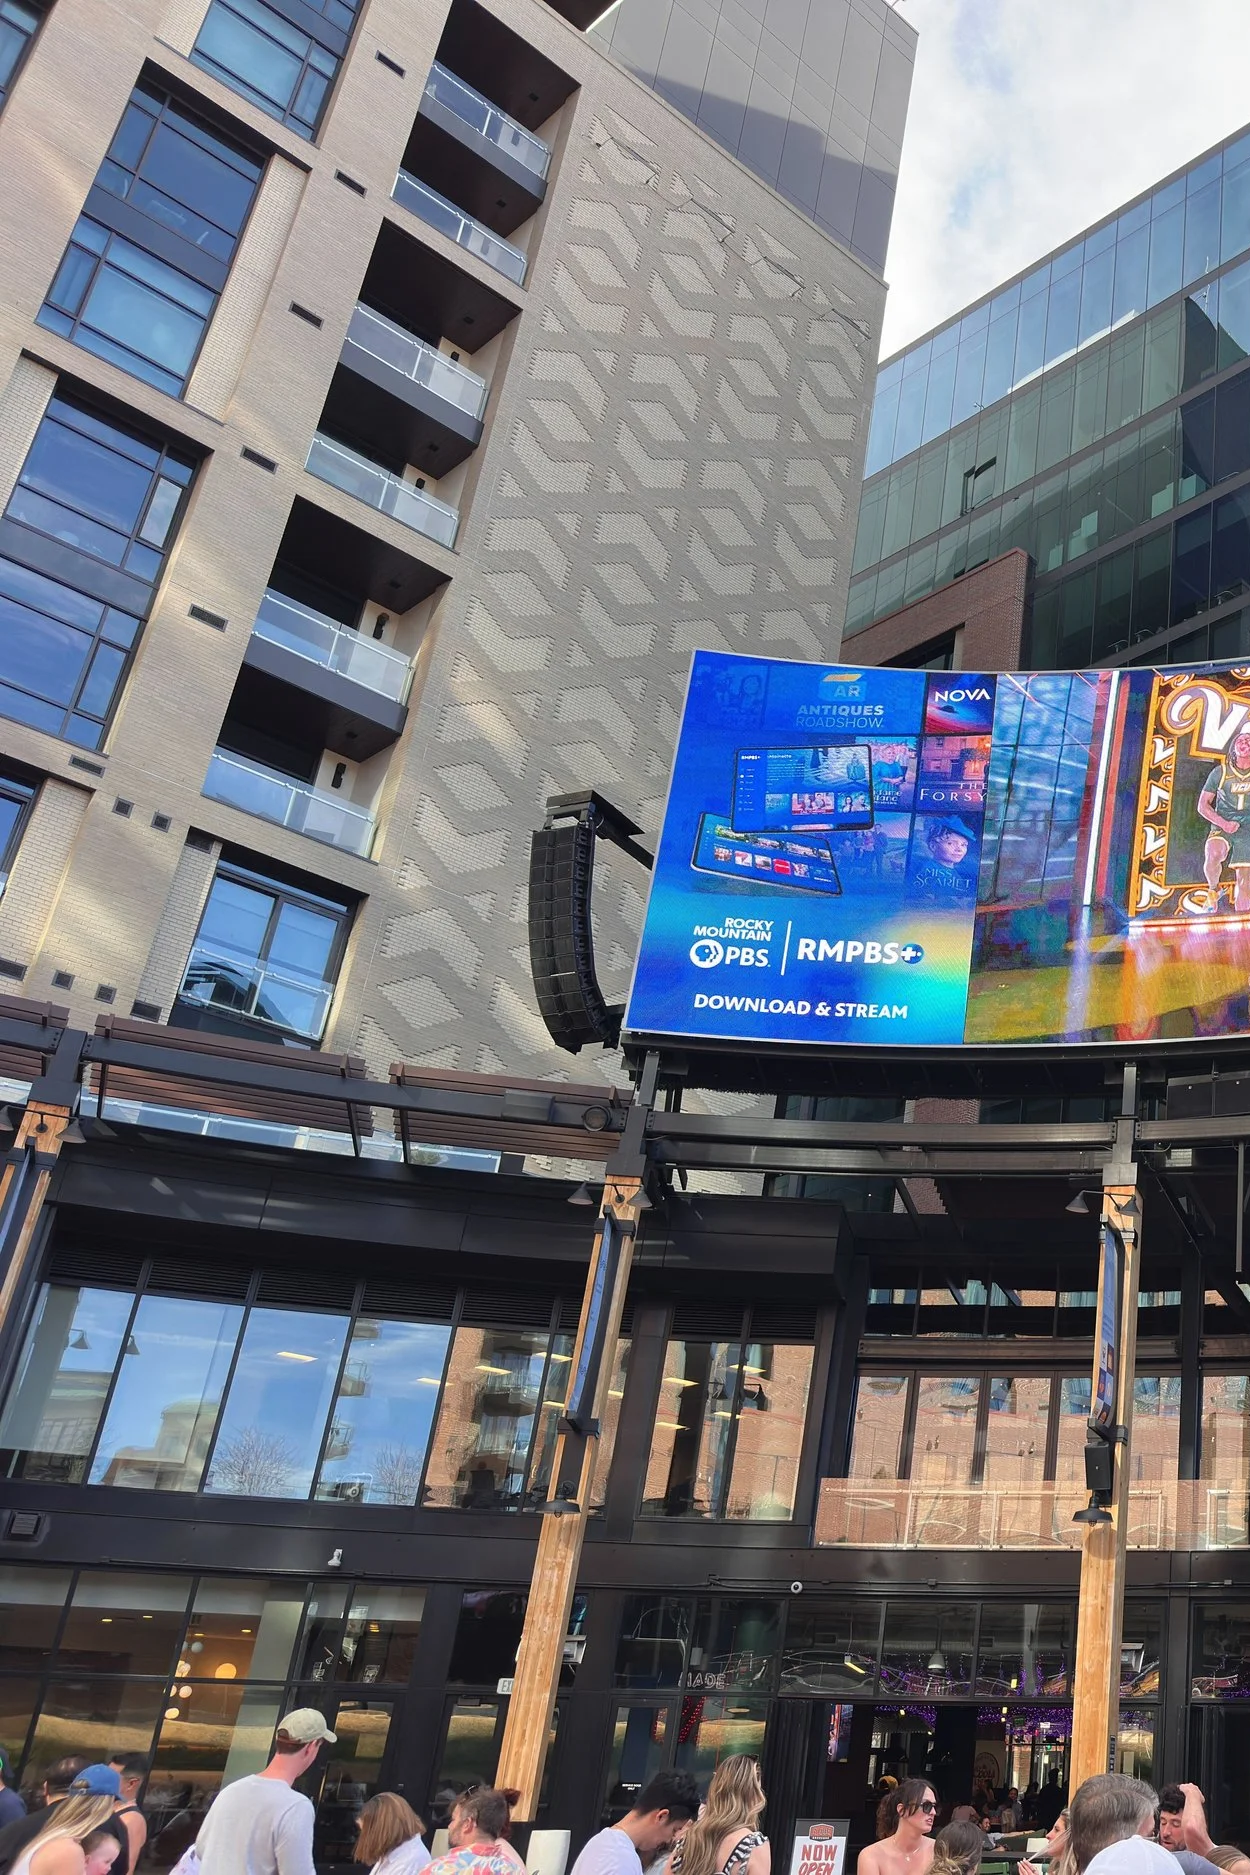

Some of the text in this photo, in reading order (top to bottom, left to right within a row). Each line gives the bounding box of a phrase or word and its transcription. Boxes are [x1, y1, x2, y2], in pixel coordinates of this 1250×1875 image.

[834, 685, 860, 698] AR
[935, 688, 991, 702] NOVA
[797, 704, 885, 716] ANTIQUES
[796, 717, 884, 728] ROADSHOW
[960, 782, 988, 790] THE
[1237, 794, 1245, 811] 1
[925, 868, 952, 877] MISS
[912, 874, 973, 891] SCARLET
[724, 917, 774, 931] ROCKY
[693, 925, 772, 942] MOUNTAIN
[725, 946, 769, 967] PBS
[693, 993, 909, 1019] DOWNLOAD & STREAM
[801, 1845, 838, 1861] NOW
[798, 1862, 835, 1875] OPEN
